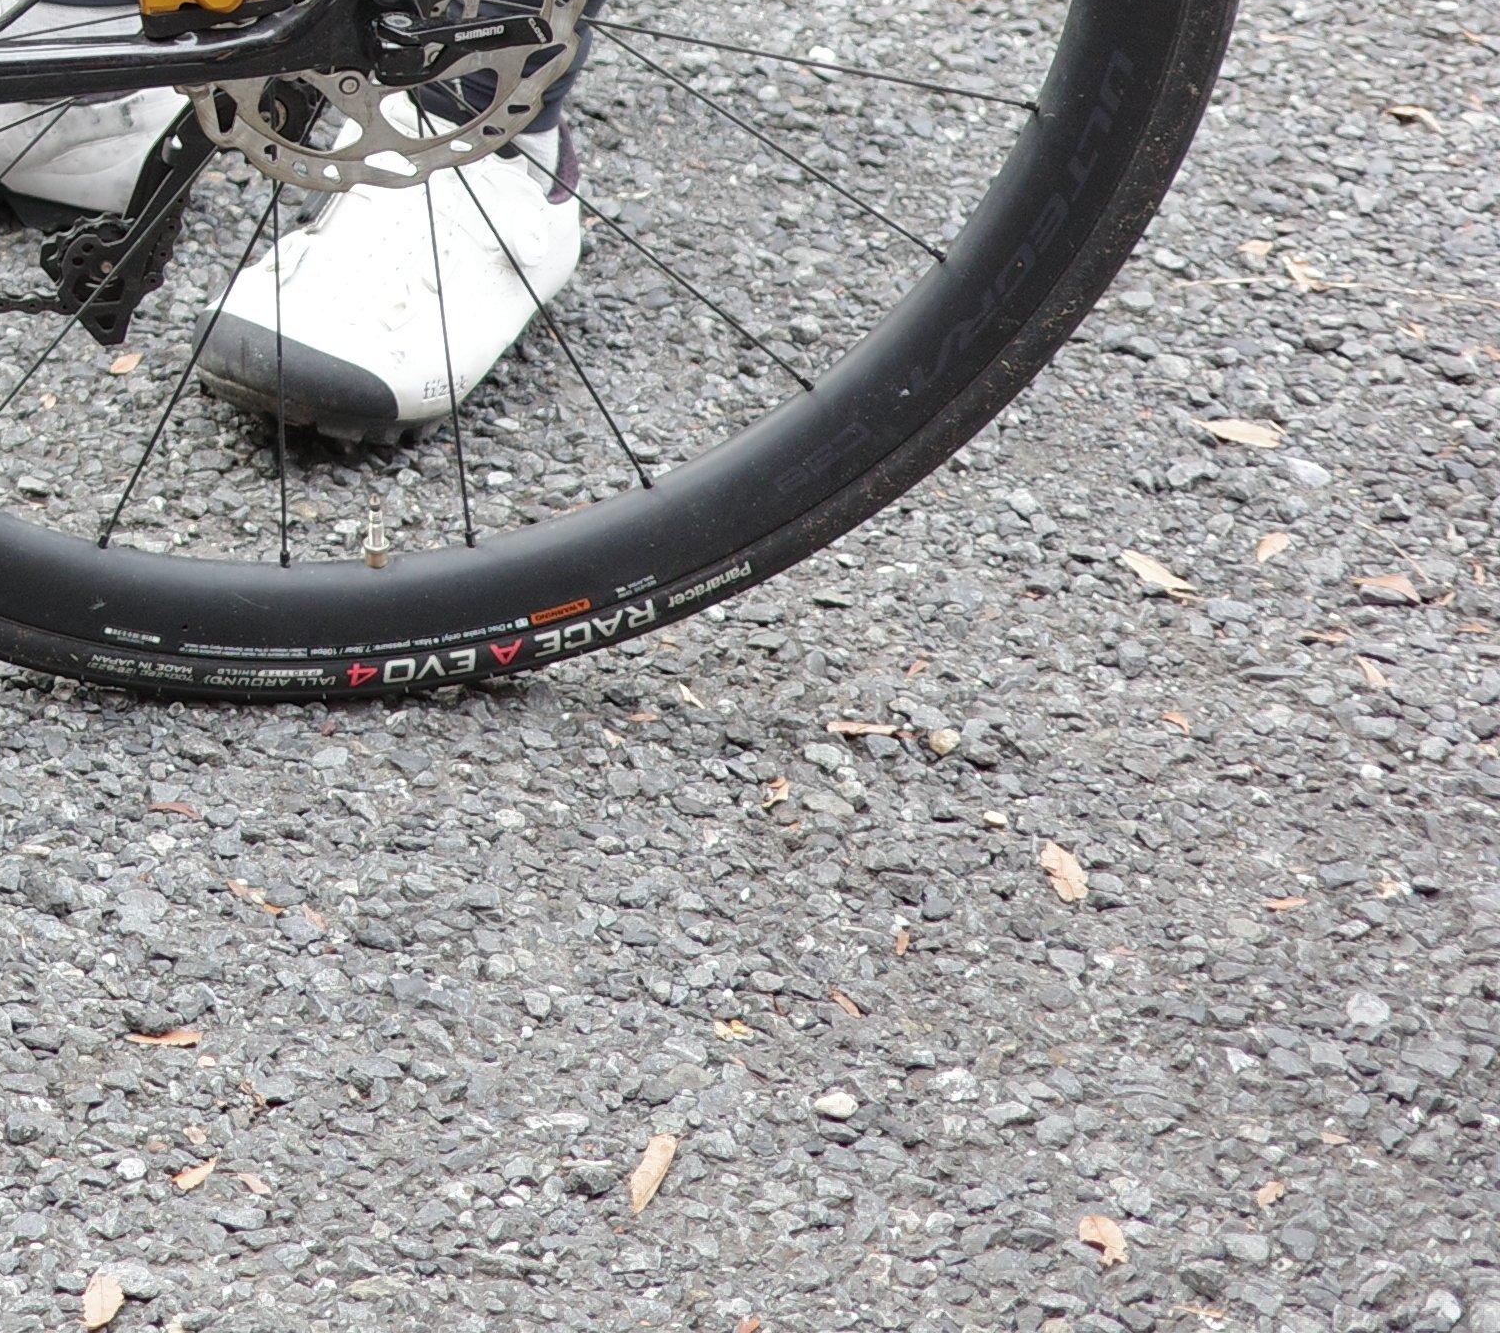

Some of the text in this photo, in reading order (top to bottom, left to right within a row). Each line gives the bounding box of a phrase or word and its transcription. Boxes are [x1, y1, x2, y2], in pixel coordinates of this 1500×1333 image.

[454, 24, 505, 43] SHIMANO
[667, 560, 753, 610] Panaracer
[533, 597, 658, 659] RACE
[90, 652, 193, 675] MADE IN JAPAN
[382, 648, 477, 684] EVO
[488, 637, 524, 666] A
[346, 661, 380, 688] 4
